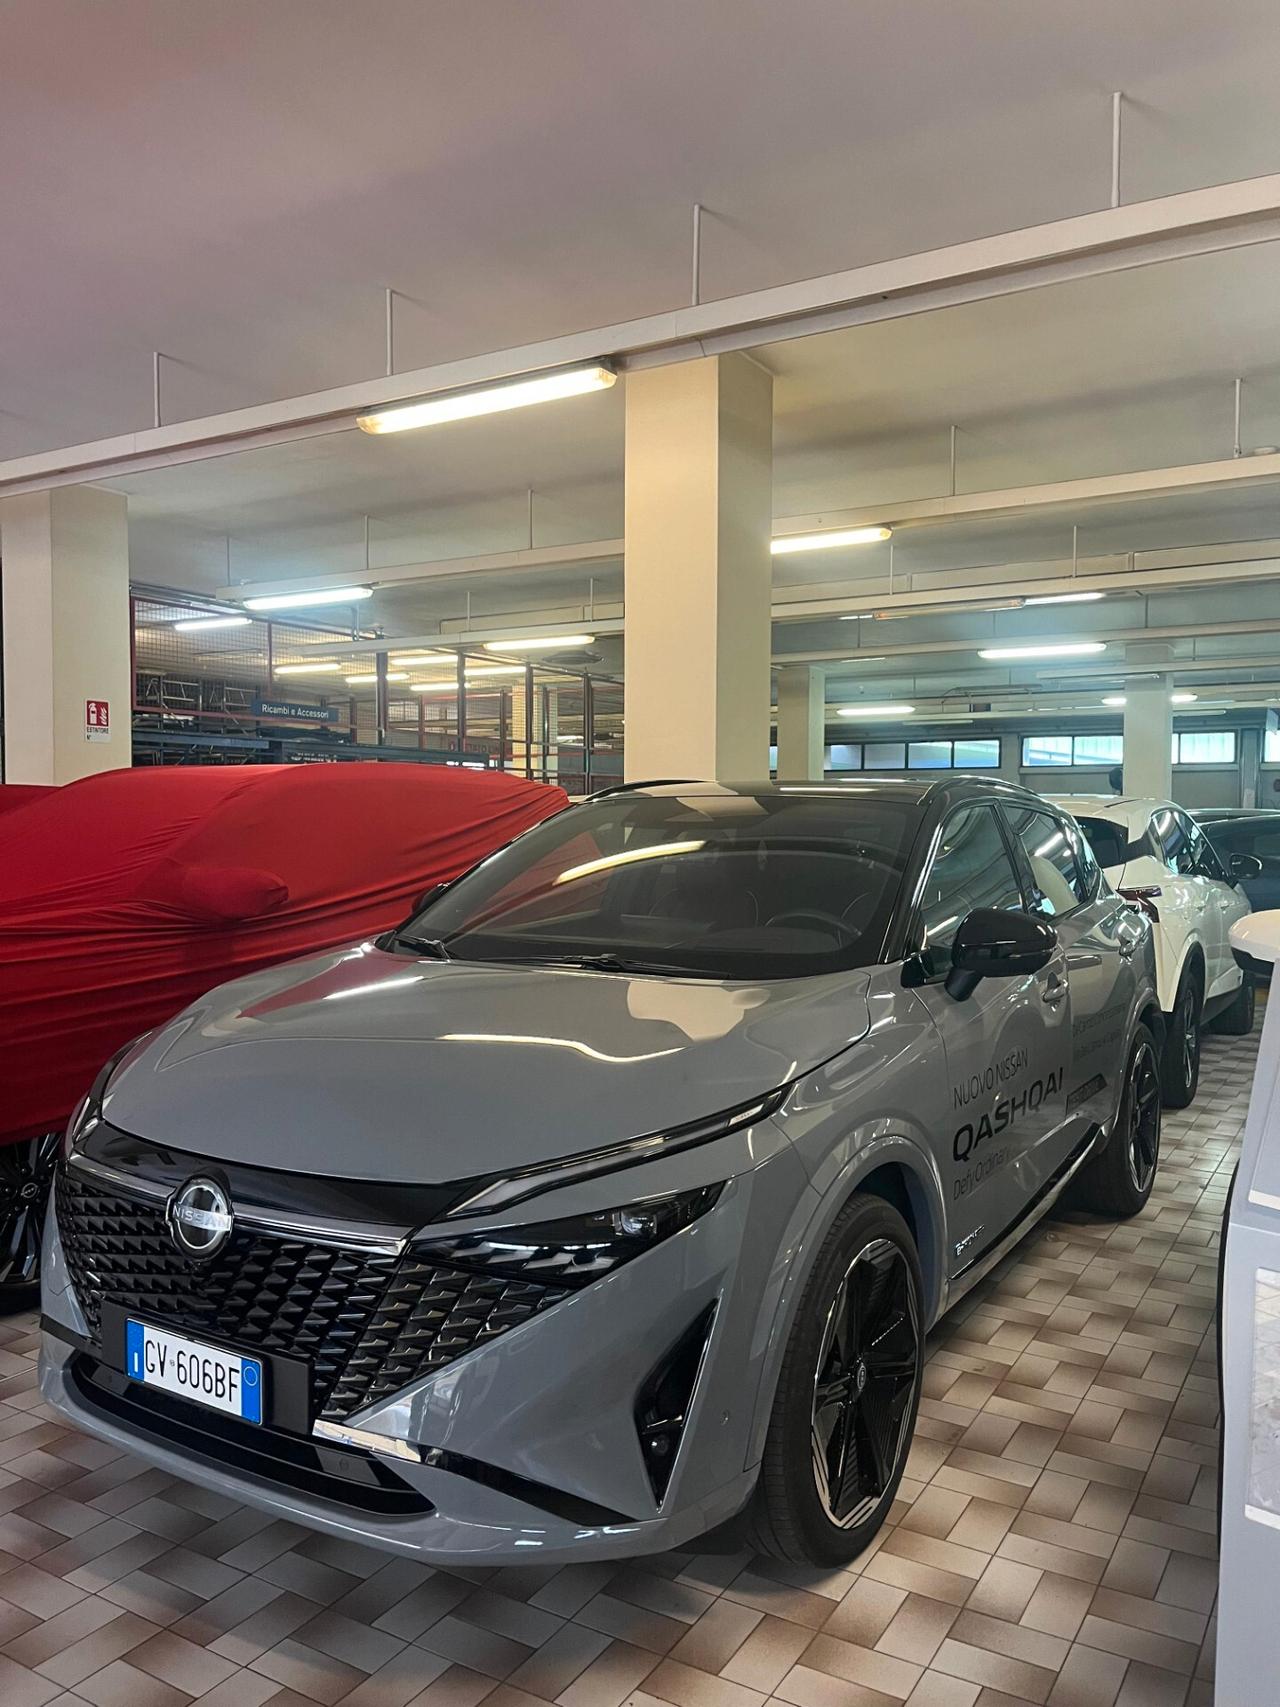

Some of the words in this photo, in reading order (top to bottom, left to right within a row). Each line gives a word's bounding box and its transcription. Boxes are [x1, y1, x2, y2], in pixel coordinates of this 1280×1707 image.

[262, 704, 289, 715] Ricambi
[297, 707, 329, 719] Accessori
[953, 1066, 994, 1110] NUOVO
[997, 1048, 1029, 1083] NISSAN
[953, 1067, 1064, 1163] QASHQAI
[953, 1168, 975, 1200] Defy
[145, 1340, 167, 1378] GV
[176, 1350, 240, 1402] 606BF
